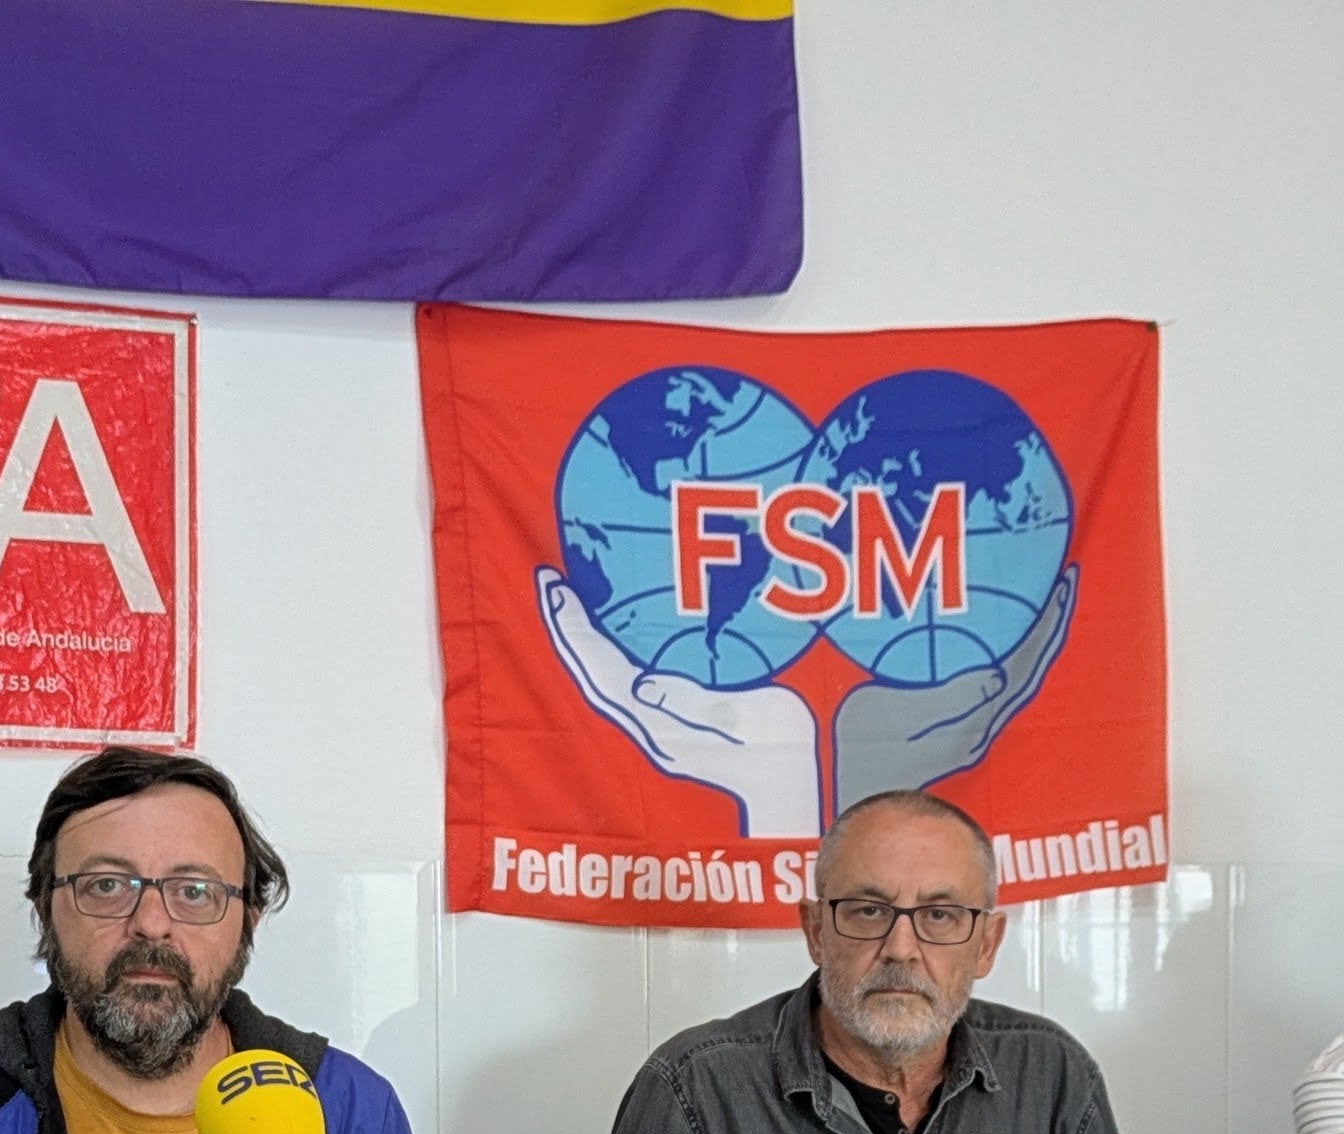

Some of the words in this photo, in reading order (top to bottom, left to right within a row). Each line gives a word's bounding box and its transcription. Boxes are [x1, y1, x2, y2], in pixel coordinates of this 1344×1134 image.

[671, 480, 968, 622] FSM
[8, 676, 30, 692] 53
[34, 677, 57, 694] 48
[492, 836, 765, 904] Federación
